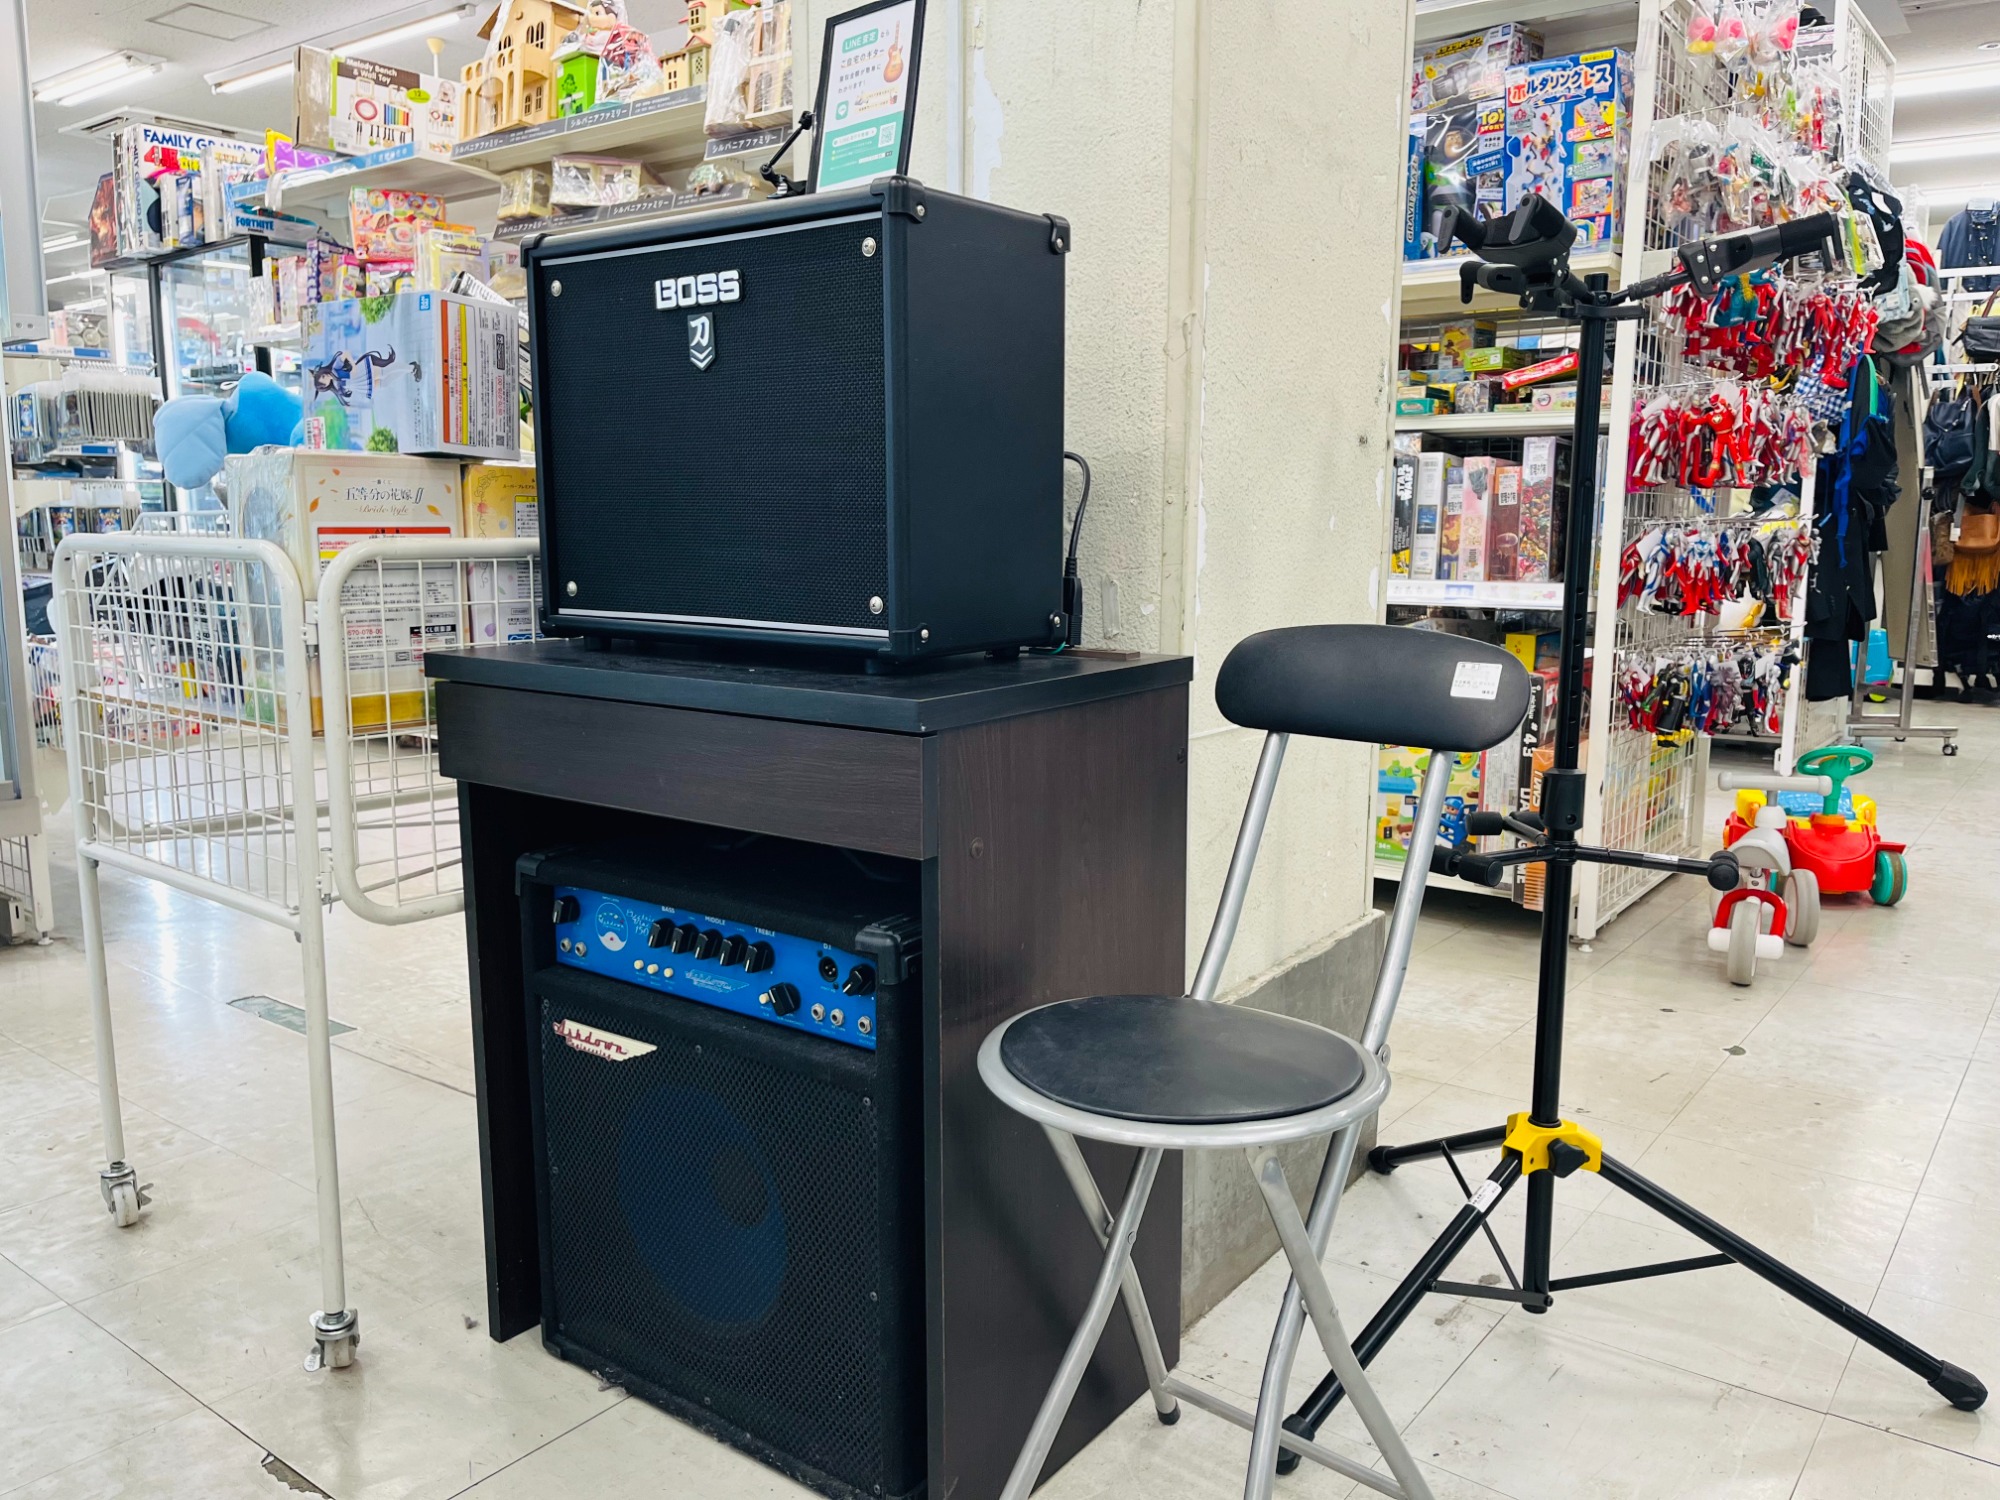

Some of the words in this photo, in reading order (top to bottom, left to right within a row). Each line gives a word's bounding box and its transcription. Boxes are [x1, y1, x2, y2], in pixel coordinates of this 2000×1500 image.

[346, 58, 374, 72] Melody
[375, 64, 398, 76] Bench
[360, 70, 376, 80] Wall
[378, 74, 392, 85] Toy
[570, 109, 628, 129] シルバニアファミリー
[143, 129, 193, 149] FAMILY
[712, 134, 778, 154] シルバニアファミリー
[613, 200, 670, 216] シルバニアファミリー
[1407, 191, 1415, 241] GRAVITY
[235, 216, 275, 231] FORTNITE
[655, 269, 741, 310] BOSS
[661, 905, 676, 914] BASS
[704, 915, 726, 926] MIDDLE
[754, 926, 776, 938] TREBLE
[553, 1019, 628, 1056] Ashdown
